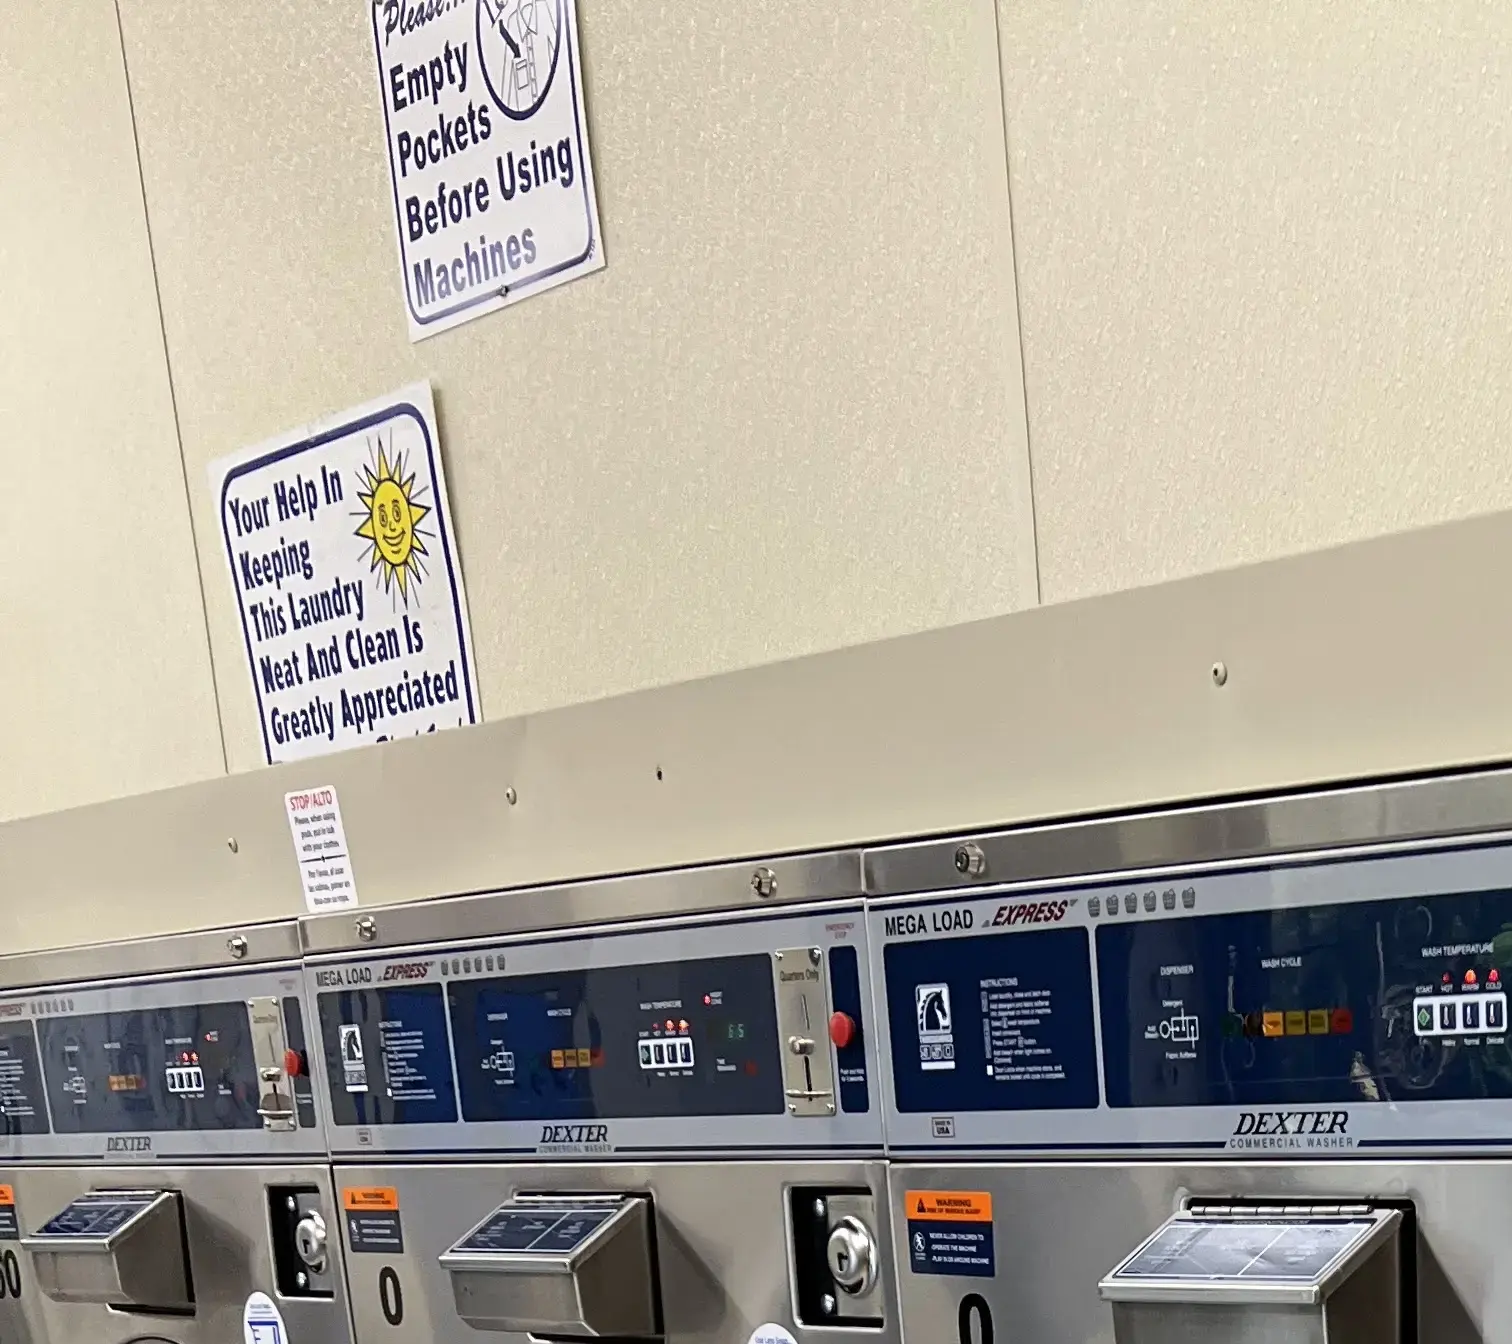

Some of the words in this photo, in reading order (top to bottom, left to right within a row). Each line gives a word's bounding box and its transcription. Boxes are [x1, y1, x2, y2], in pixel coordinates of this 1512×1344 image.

[389, 40, 468, 112] Empty
[397, 100, 492, 177] Pockets
[405, 178, 490, 242] Before
[496, 136, 575, 201] Using
[412, 227, 537, 308] Machines
[228, 496, 270, 537] Your
[272, 474, 318, 523] Help
[320, 464, 344, 505] In
[239, 538, 314, 590] Keeping
[250, 602, 288, 642] This
[289, 576, 364, 630] Laundry
[260, 648, 302, 694] Neat
[307, 638, 342, 683] And
[344, 625, 400, 670] Clean
[402, 614, 424, 655] Is
[270, 695, 334, 745] Greatly
[340, 660, 460, 734] Appreciated
[290, 790, 333, 811] STOP/ALTO
[885, 915, 928, 936] MEGA
[933, 909, 973, 932] LOAD
[992, 900, 1068, 927] EXPRESS
[316, 968, 344, 987] MEGA
[347, 966, 372, 984] LOAD
[383, 961, 430, 981] EXPRESS
[107, 1136, 151, 1151] DEXTER
[540, 1125, 607, 1143] DEXTER
[1229, 1138, 1302, 1149] COMMERCIAL
[1307, 1137, 1353, 1148] WASHER
[1233, 1111, 1349, 1136] DEXTER
[379, 1265, 403, 1326] 0
